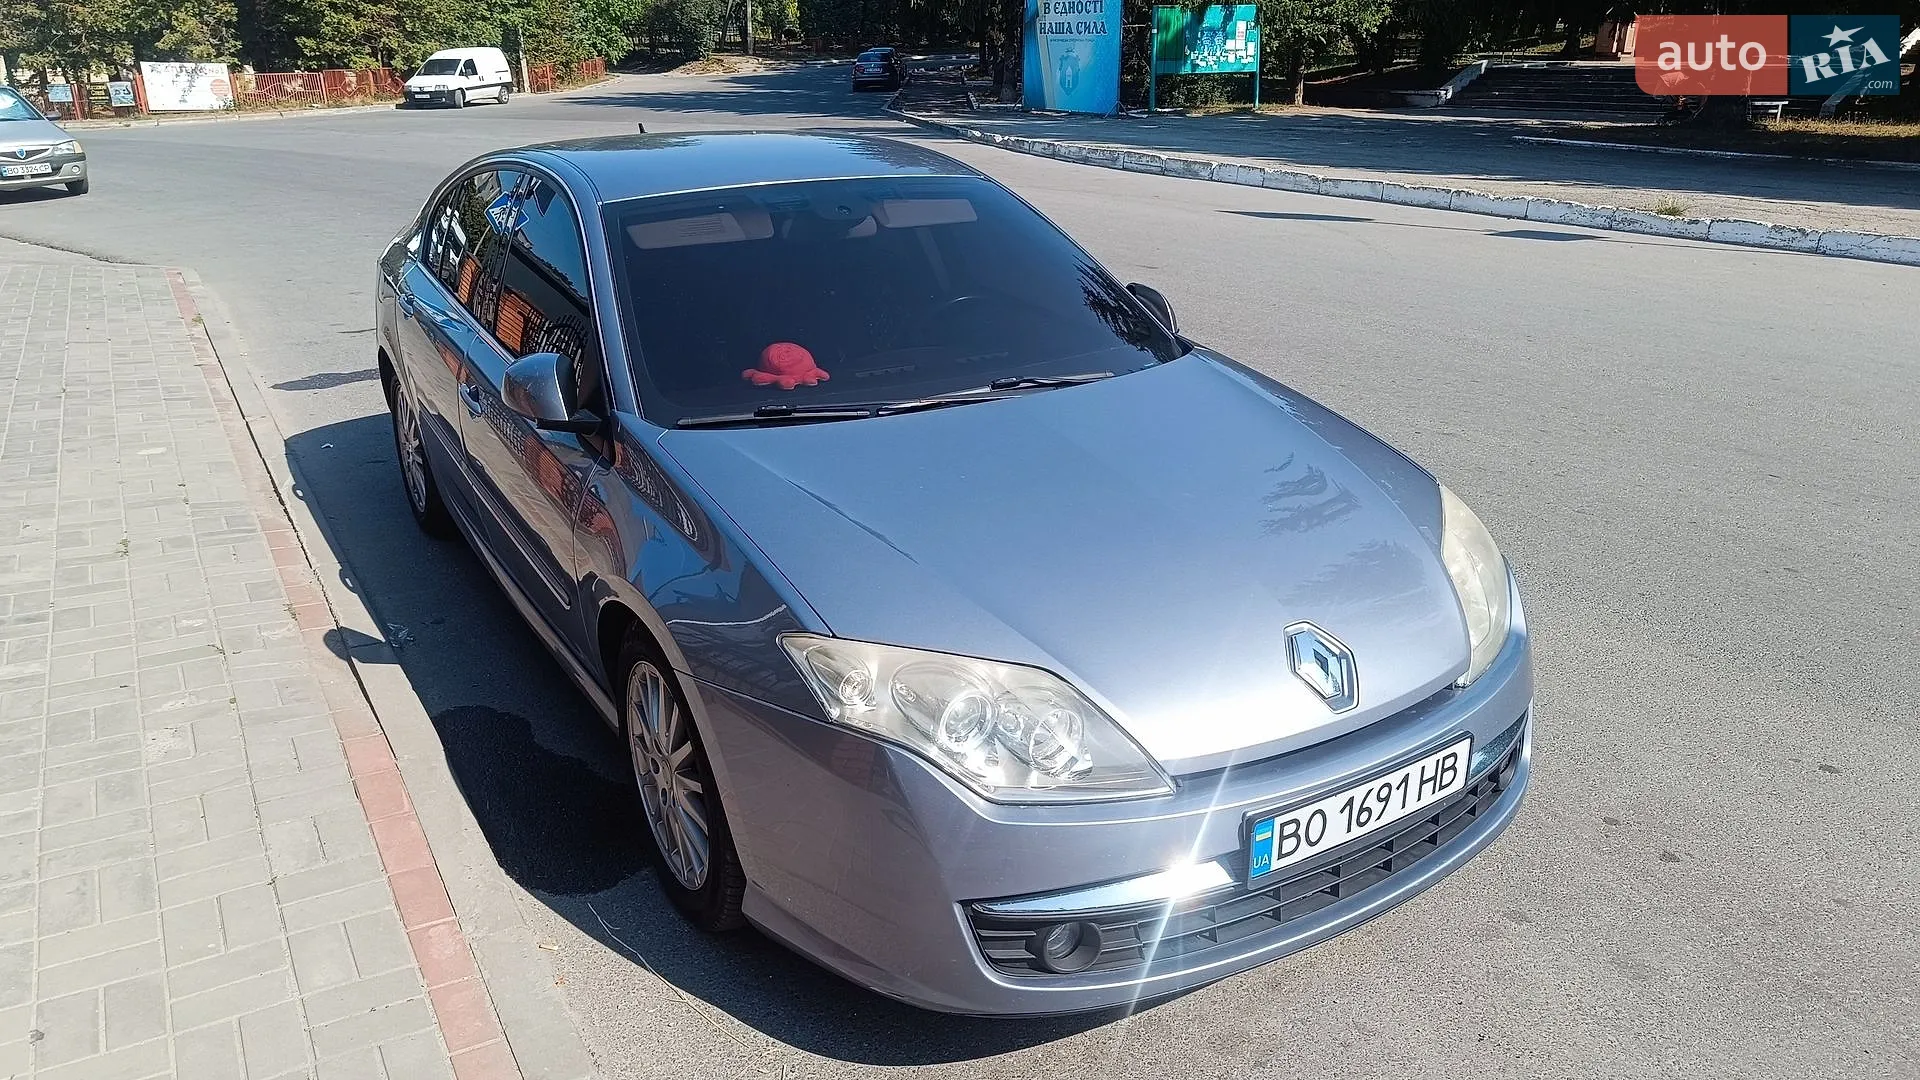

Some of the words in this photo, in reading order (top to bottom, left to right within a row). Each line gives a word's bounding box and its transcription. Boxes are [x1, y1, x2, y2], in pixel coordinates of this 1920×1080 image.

[1043, 2, 1051, 15] В
[1053, 0, 1104, 16] ЄДНОСТІ
[1039, 21, 1074, 35] НАША
[1075, 21, 1108, 35] СИЛА
[1277, 808, 1326, 861] BO
[1339, 773, 1410, 834] 1691
[1416, 751, 1459, 802] HB
[1253, 853, 1270, 869] UA
